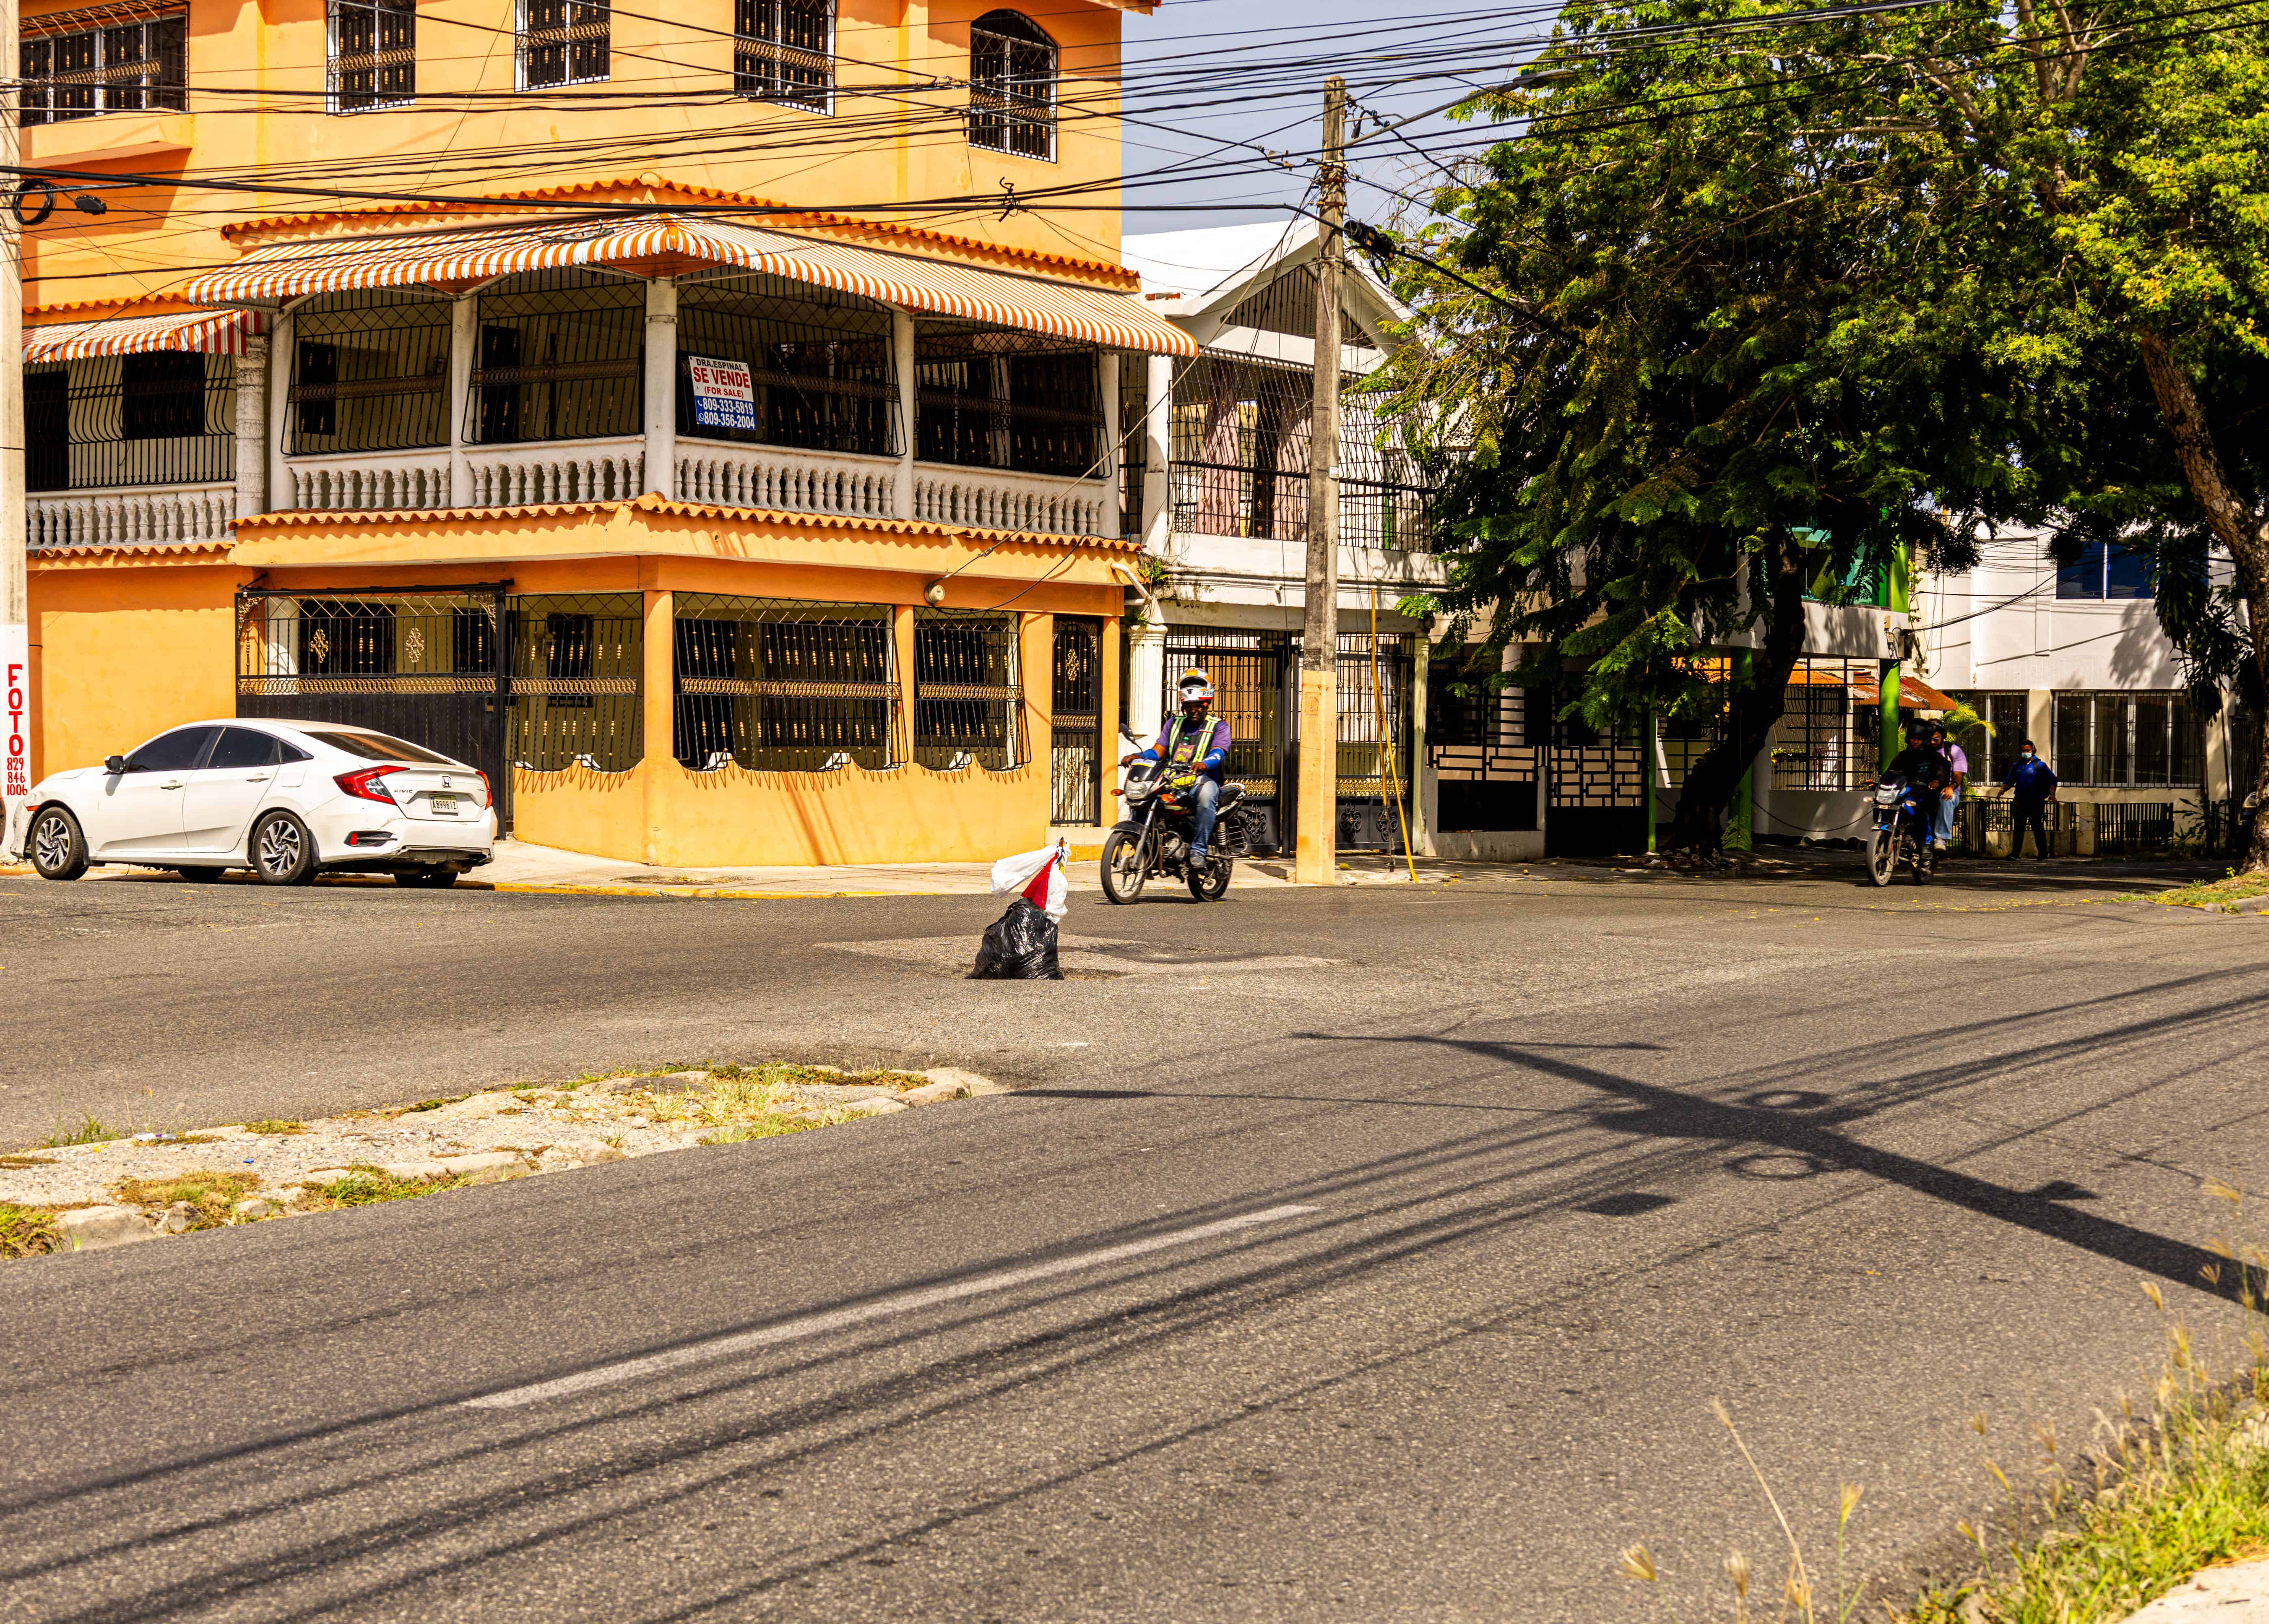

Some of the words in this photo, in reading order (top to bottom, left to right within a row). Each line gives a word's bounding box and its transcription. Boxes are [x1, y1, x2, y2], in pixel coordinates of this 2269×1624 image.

[693, 367, 709, 383] SE
[711, 369, 750, 388] VENDE
[704, 387, 722, 395] (FOR
[723, 388, 744, 399] SALE)
[703, 397, 753, 415] 809-333-5819
[704, 412, 755, 429] 809-356-2004
[8, 664, 23, 756] FOTO
[7, 757, 24, 771] 829
[8, 772, 25, 783] 846
[7, 784, 28, 795] 1006
[433, 800, 456, 810] A899812
